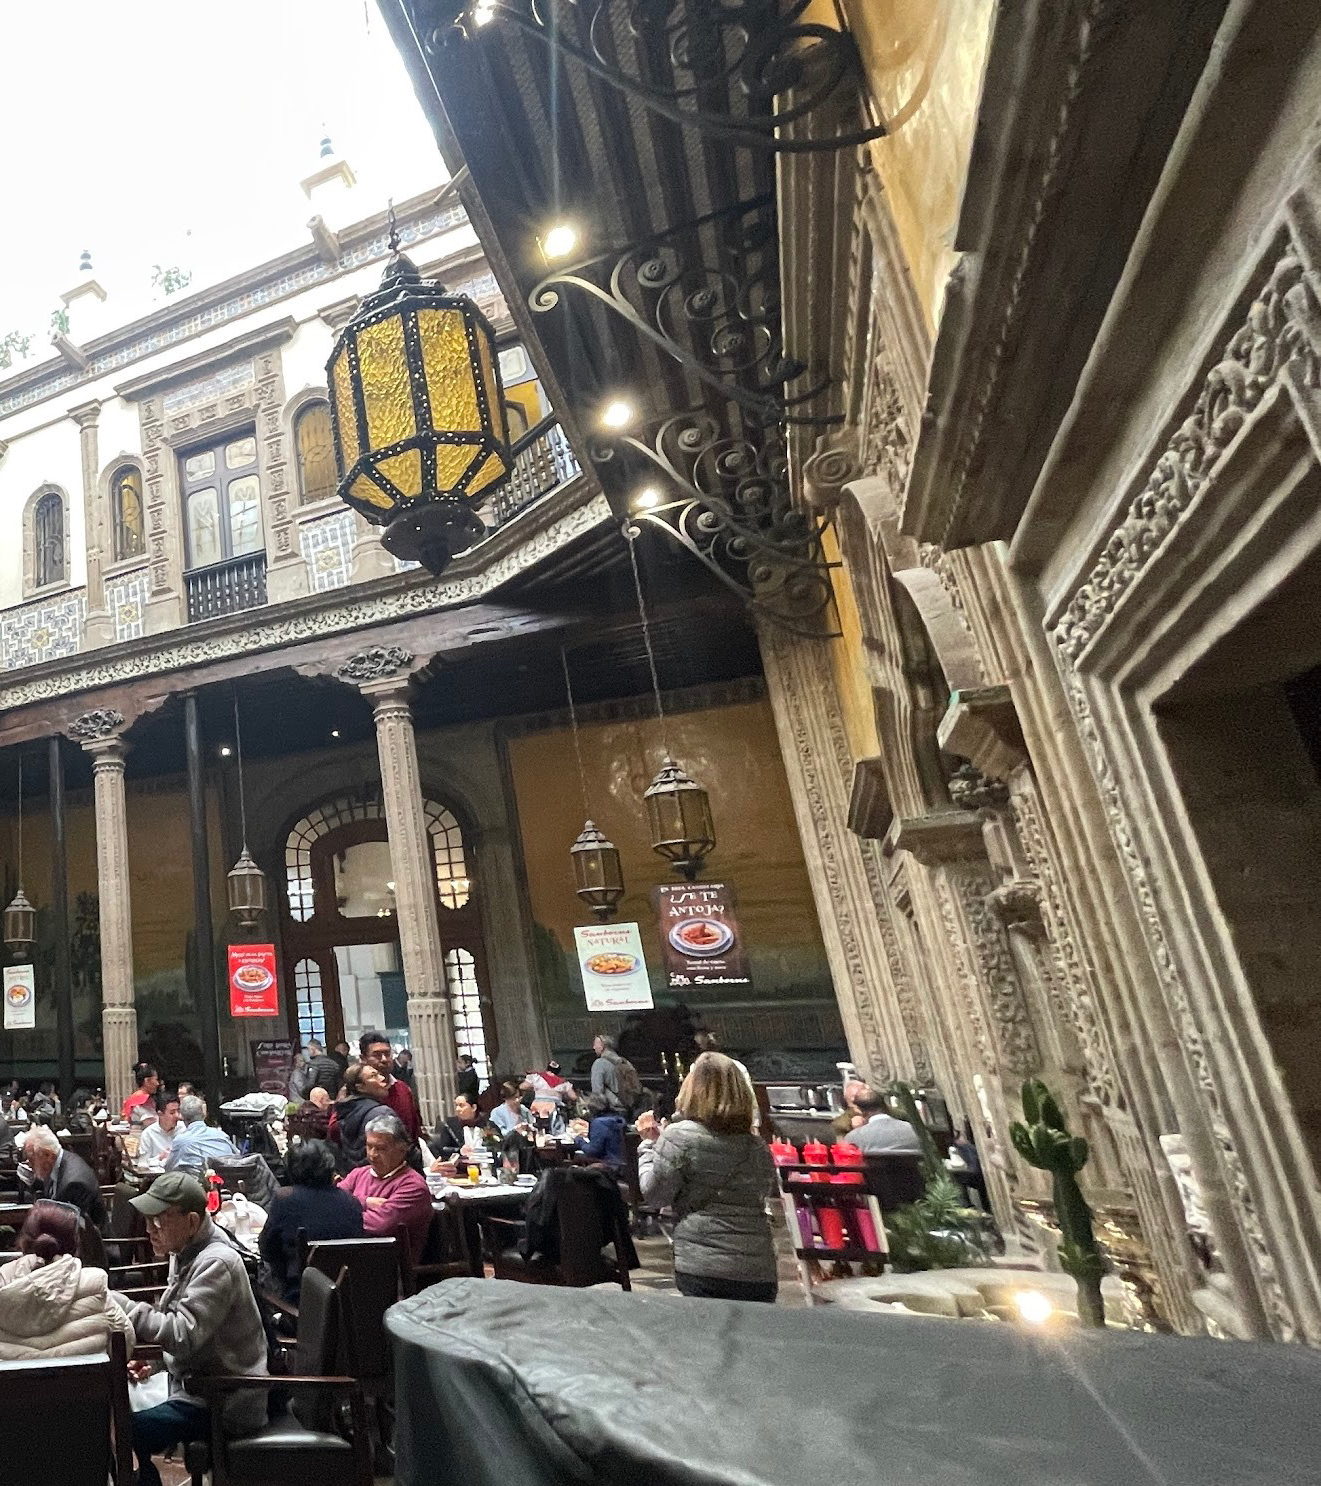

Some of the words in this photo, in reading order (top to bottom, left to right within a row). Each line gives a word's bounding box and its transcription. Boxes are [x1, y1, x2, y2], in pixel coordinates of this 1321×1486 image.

[699, 890, 718, 902] TE
[669, 904, 725, 917] ANTOJA?
[586, 936, 630, 947] NATURAL
[694, 975, 750, 985] Sanborns
